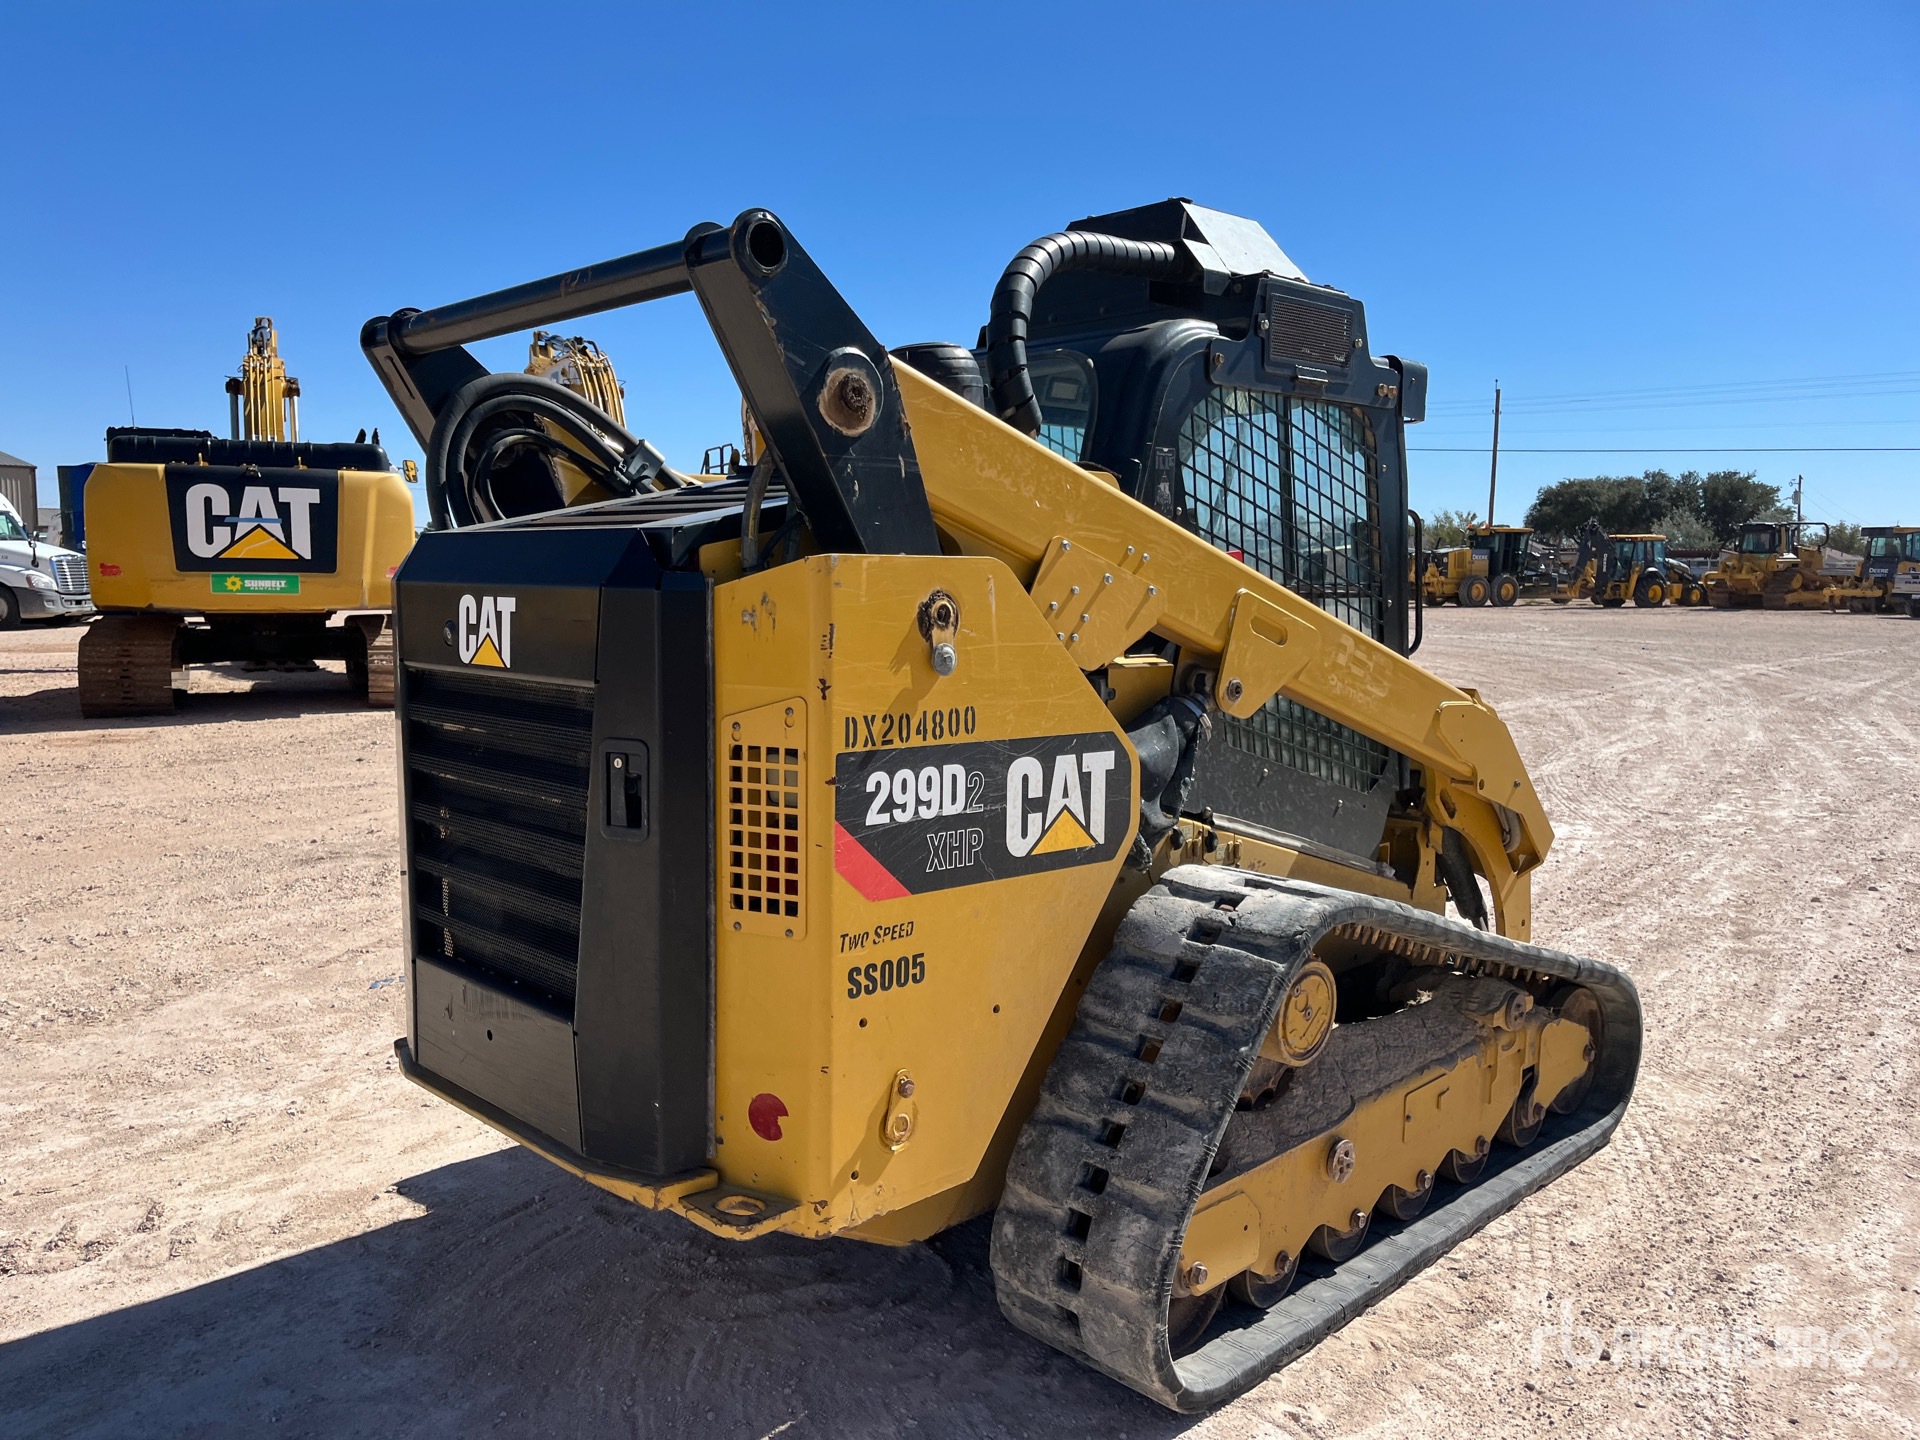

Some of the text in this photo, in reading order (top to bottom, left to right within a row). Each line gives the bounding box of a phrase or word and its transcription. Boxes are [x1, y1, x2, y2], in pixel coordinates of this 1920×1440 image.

[185, 482, 321, 560] CAT
[244, 579, 287, 588] SUNBELT
[458, 594, 516, 669] CAT
[844, 705, 977, 749] DX204800
[1006, 750, 1115, 858] CAT
[926, 828, 985, 873] XHP
[847, 952, 925, 1000] SS005
